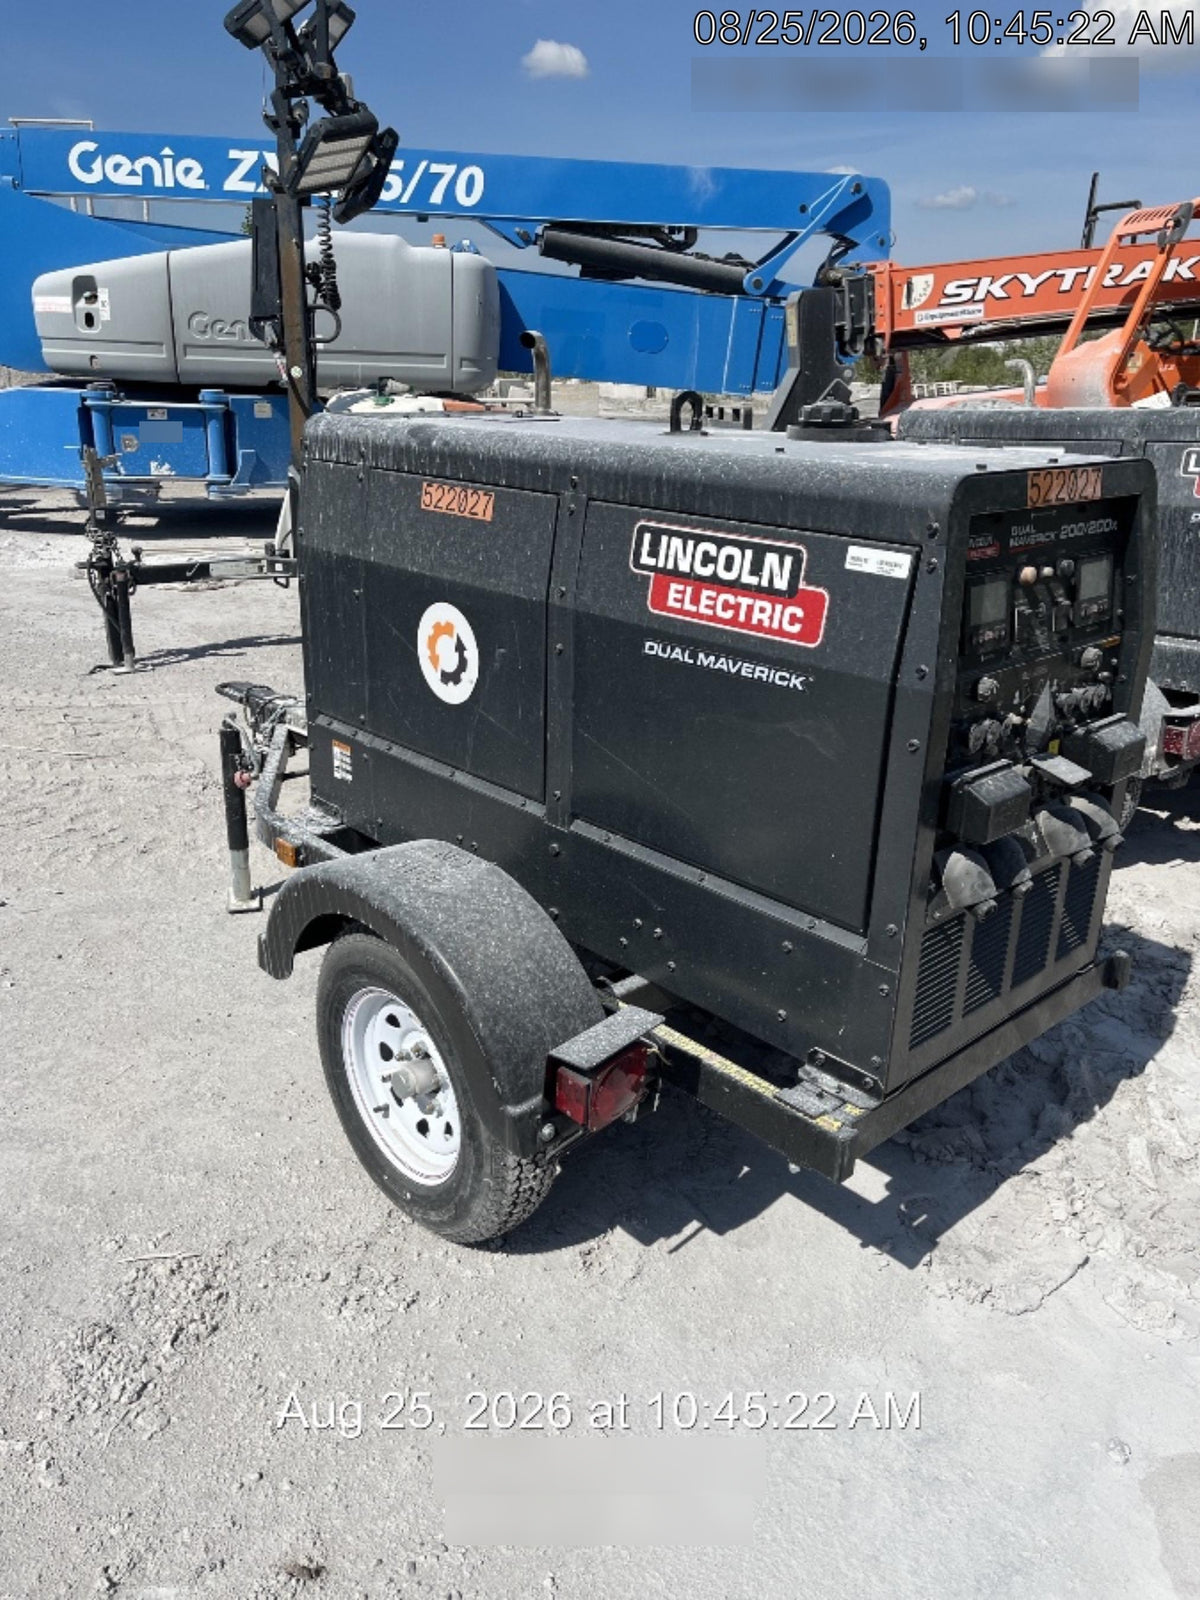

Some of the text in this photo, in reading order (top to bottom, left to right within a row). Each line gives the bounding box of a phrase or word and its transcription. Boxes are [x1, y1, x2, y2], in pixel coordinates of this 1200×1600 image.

[68, 141, 206, 189] Genie
[939, 255, 1200, 306] SKYTRAK
[422, 482, 494, 518] 522027
[1029, 468, 1102, 505] 522027
[639, 532, 794, 591] LINCOLN
[666, 581, 805, 634] ELECTRIC
[644, 641, 694, 664] DUAL
